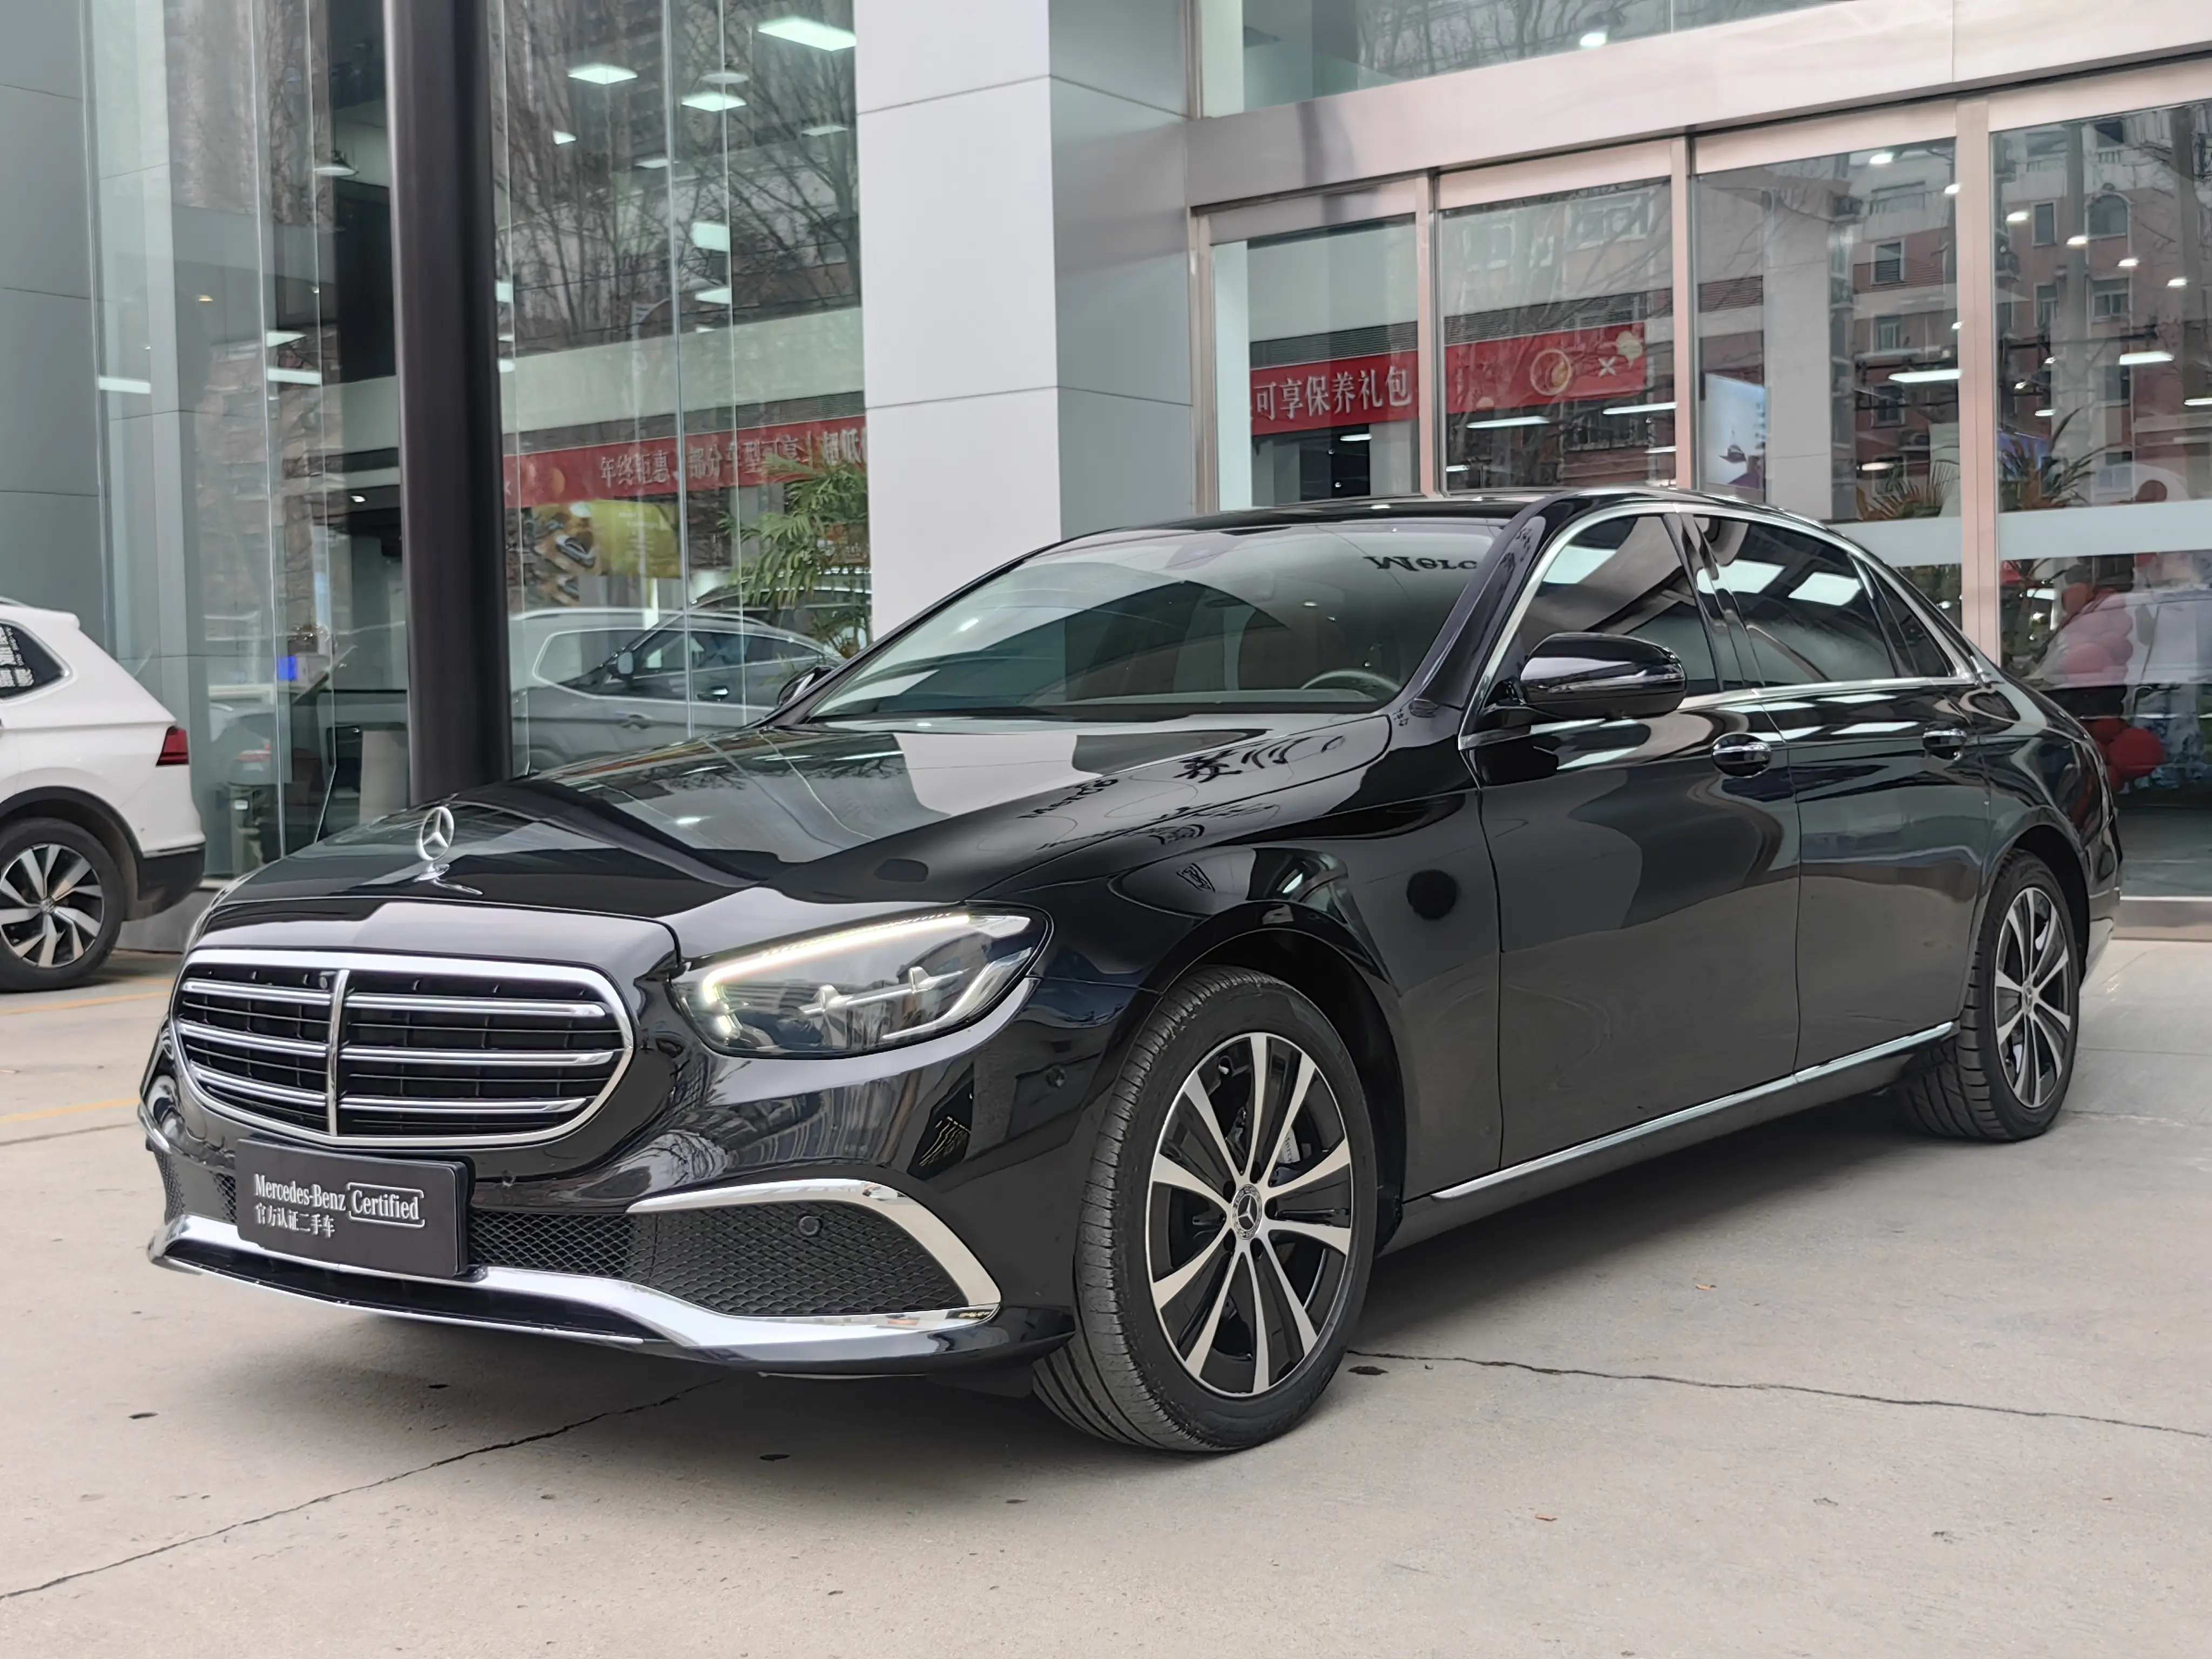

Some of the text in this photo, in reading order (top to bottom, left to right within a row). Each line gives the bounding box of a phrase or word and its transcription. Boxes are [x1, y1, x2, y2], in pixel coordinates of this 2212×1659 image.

[1253, 366, 1413, 421] 可享保养礼包
[254, 1174, 420, 1220] Mercedes-Benz Certified
[255, 1203, 335, 1238] 官方认证二手车
